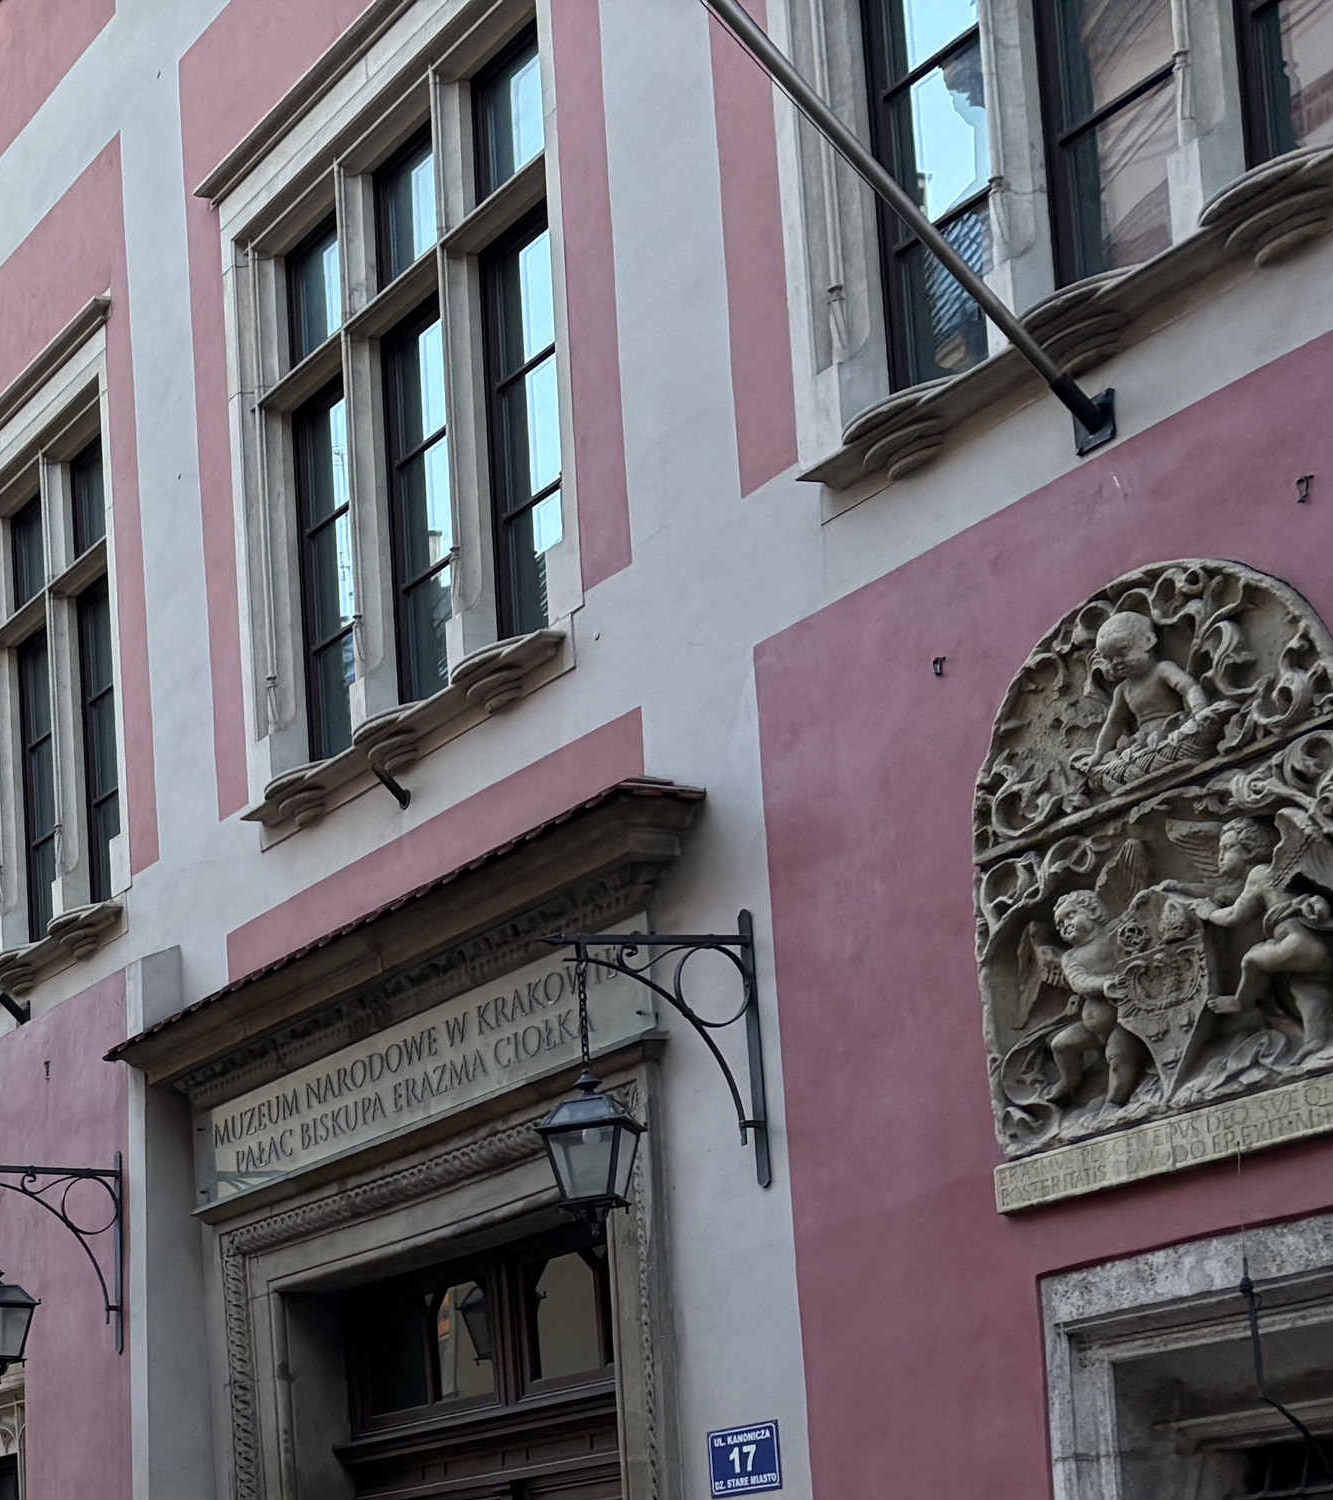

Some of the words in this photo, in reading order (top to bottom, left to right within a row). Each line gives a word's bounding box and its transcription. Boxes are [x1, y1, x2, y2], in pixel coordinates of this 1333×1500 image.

[213, 1085, 300, 1149] MUZEUM
[305, 1026, 438, 1108] NARODOWE
[444, 1014, 468, 1048] W
[235, 1130, 294, 1173] PAŁAC
[300, 1096, 386, 1150] BISKUPA
[392, 1047, 488, 1114] ERAZMA
[493, 1007, 596, 1070] CIOŁKA
[714, 1437, 726, 1447] UL.
[727, 1428, 771, 1445] KANONICZA
[729, 1444, 757, 1474] 17
[727, 1476, 749, 1489] STARE
[750, 1472, 777, 1485] MIASTO
